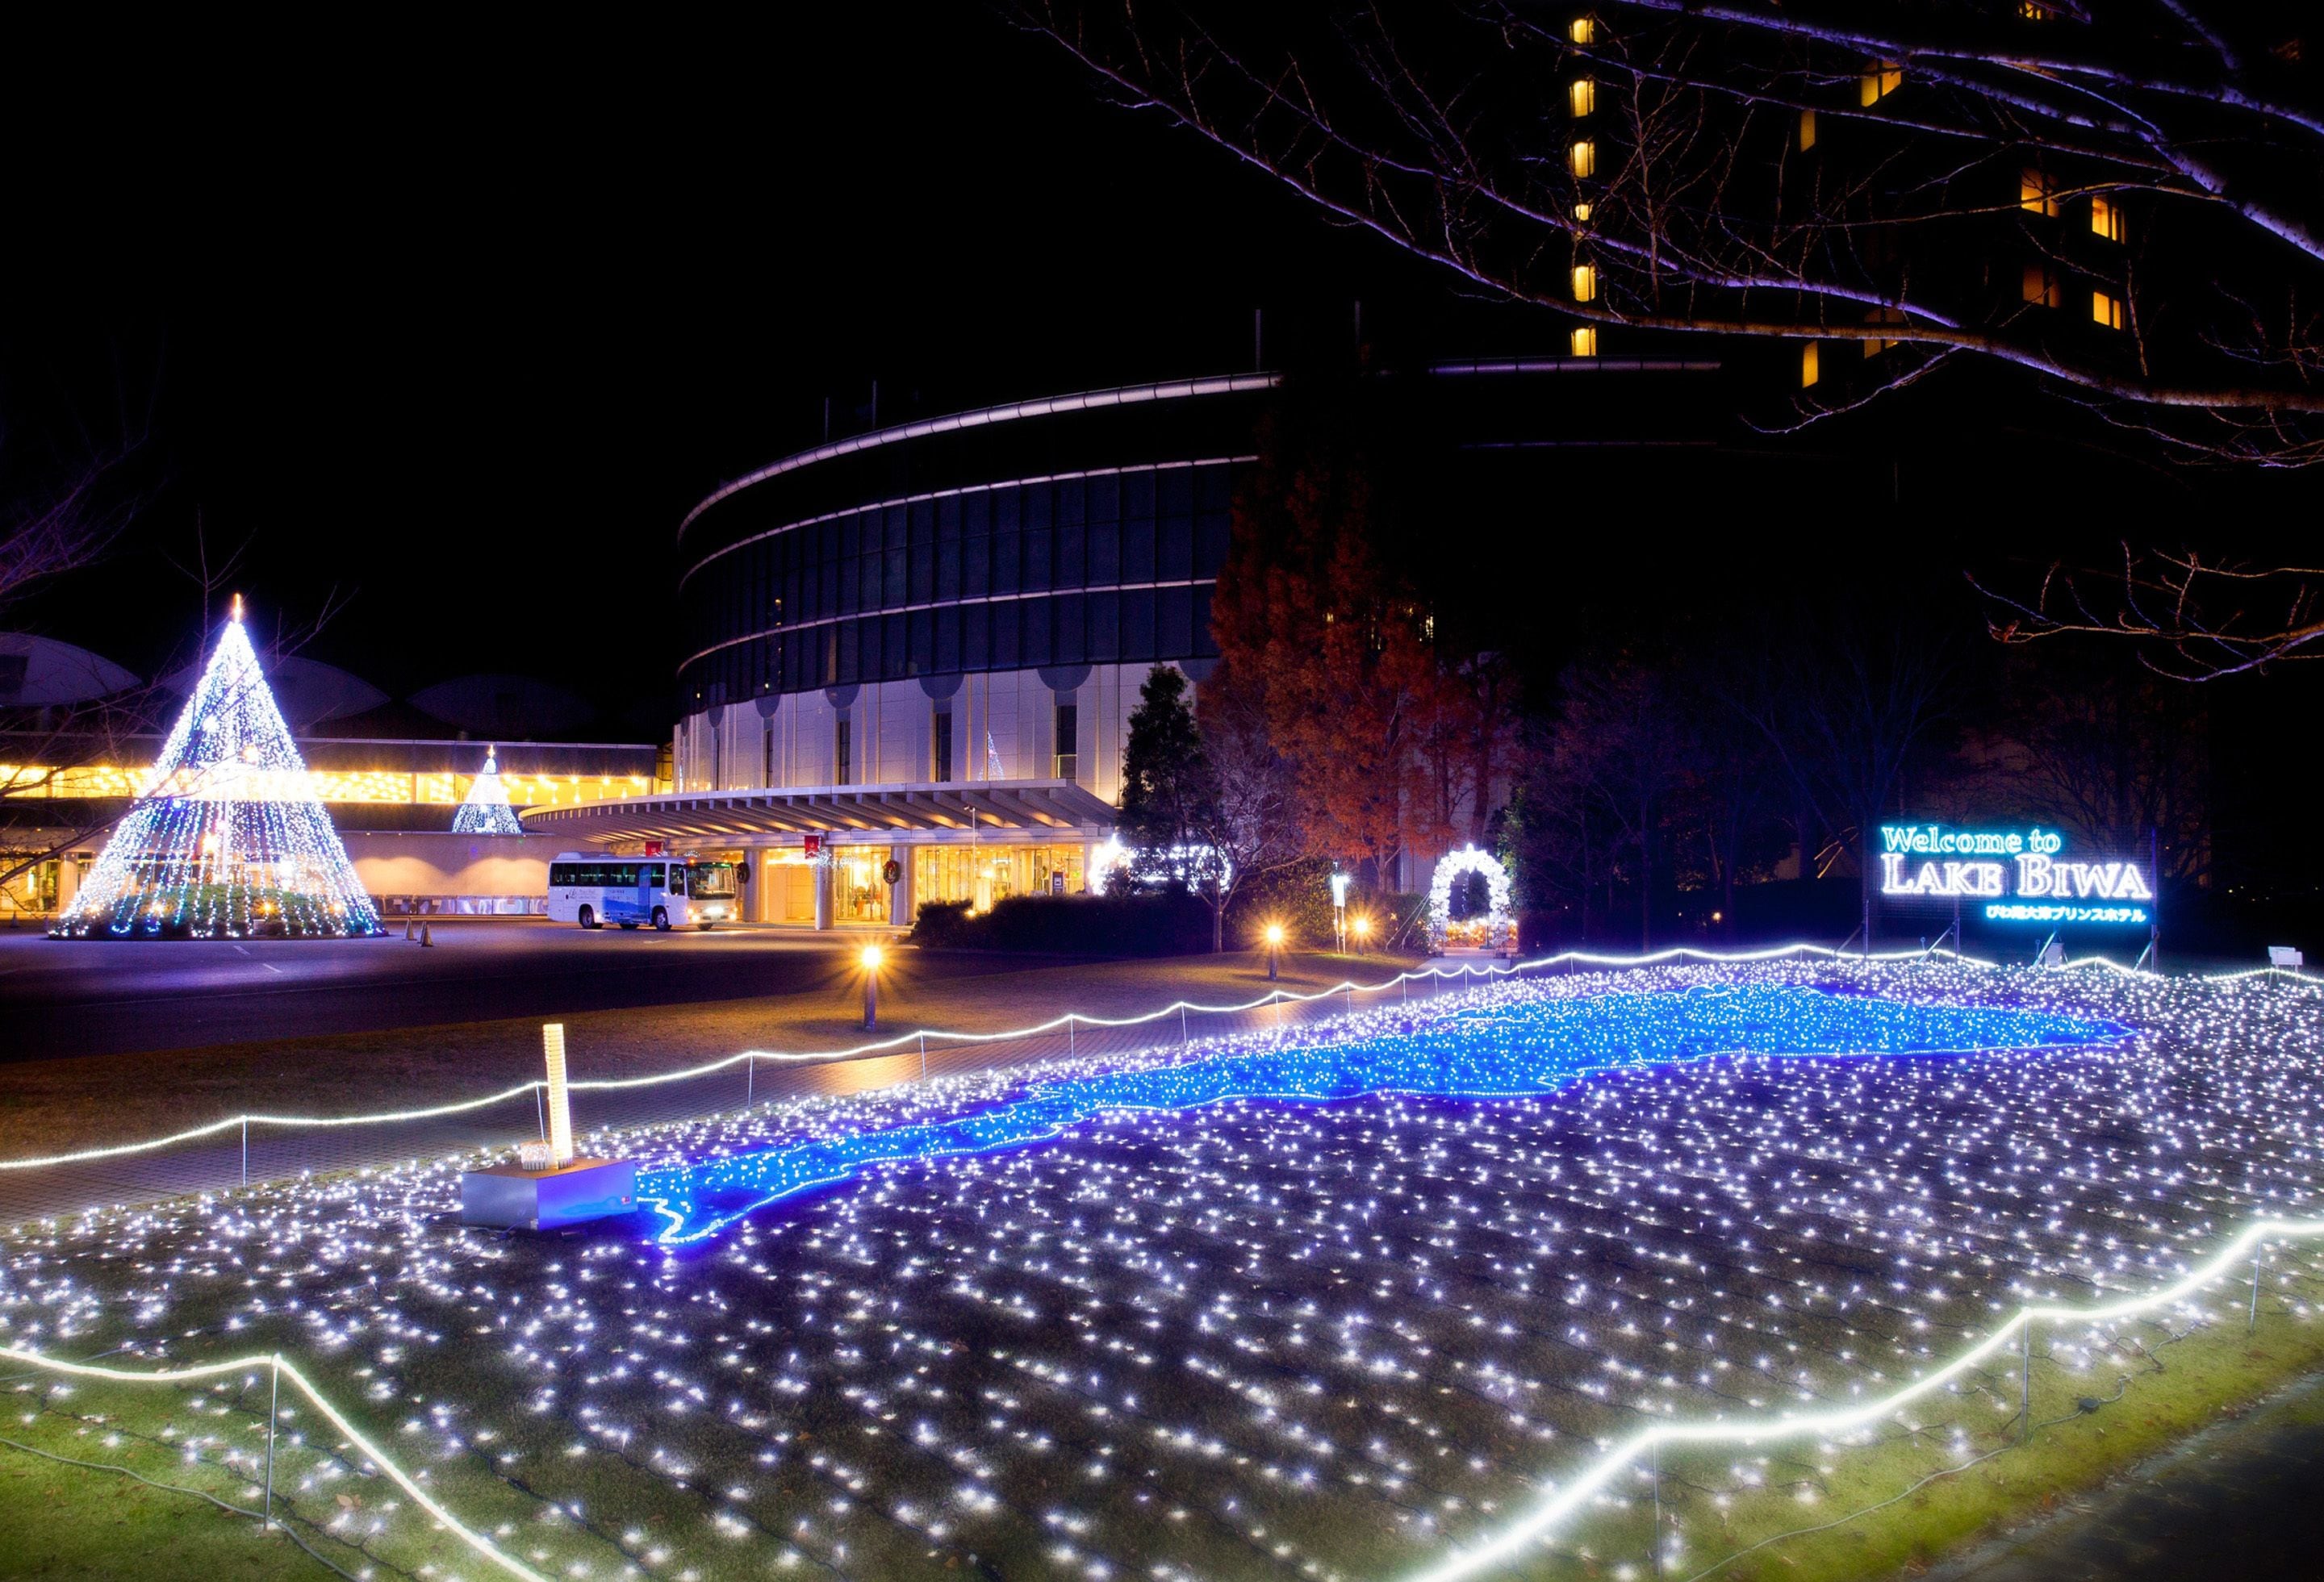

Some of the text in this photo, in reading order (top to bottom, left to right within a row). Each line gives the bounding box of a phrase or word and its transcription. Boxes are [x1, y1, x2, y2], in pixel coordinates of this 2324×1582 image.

[1881, 825, 2062, 853] Welcome to
[1881, 853, 2152, 899] LAKE BIWA
[1986, 905, 2146, 922] びわ大プリンスホテル
